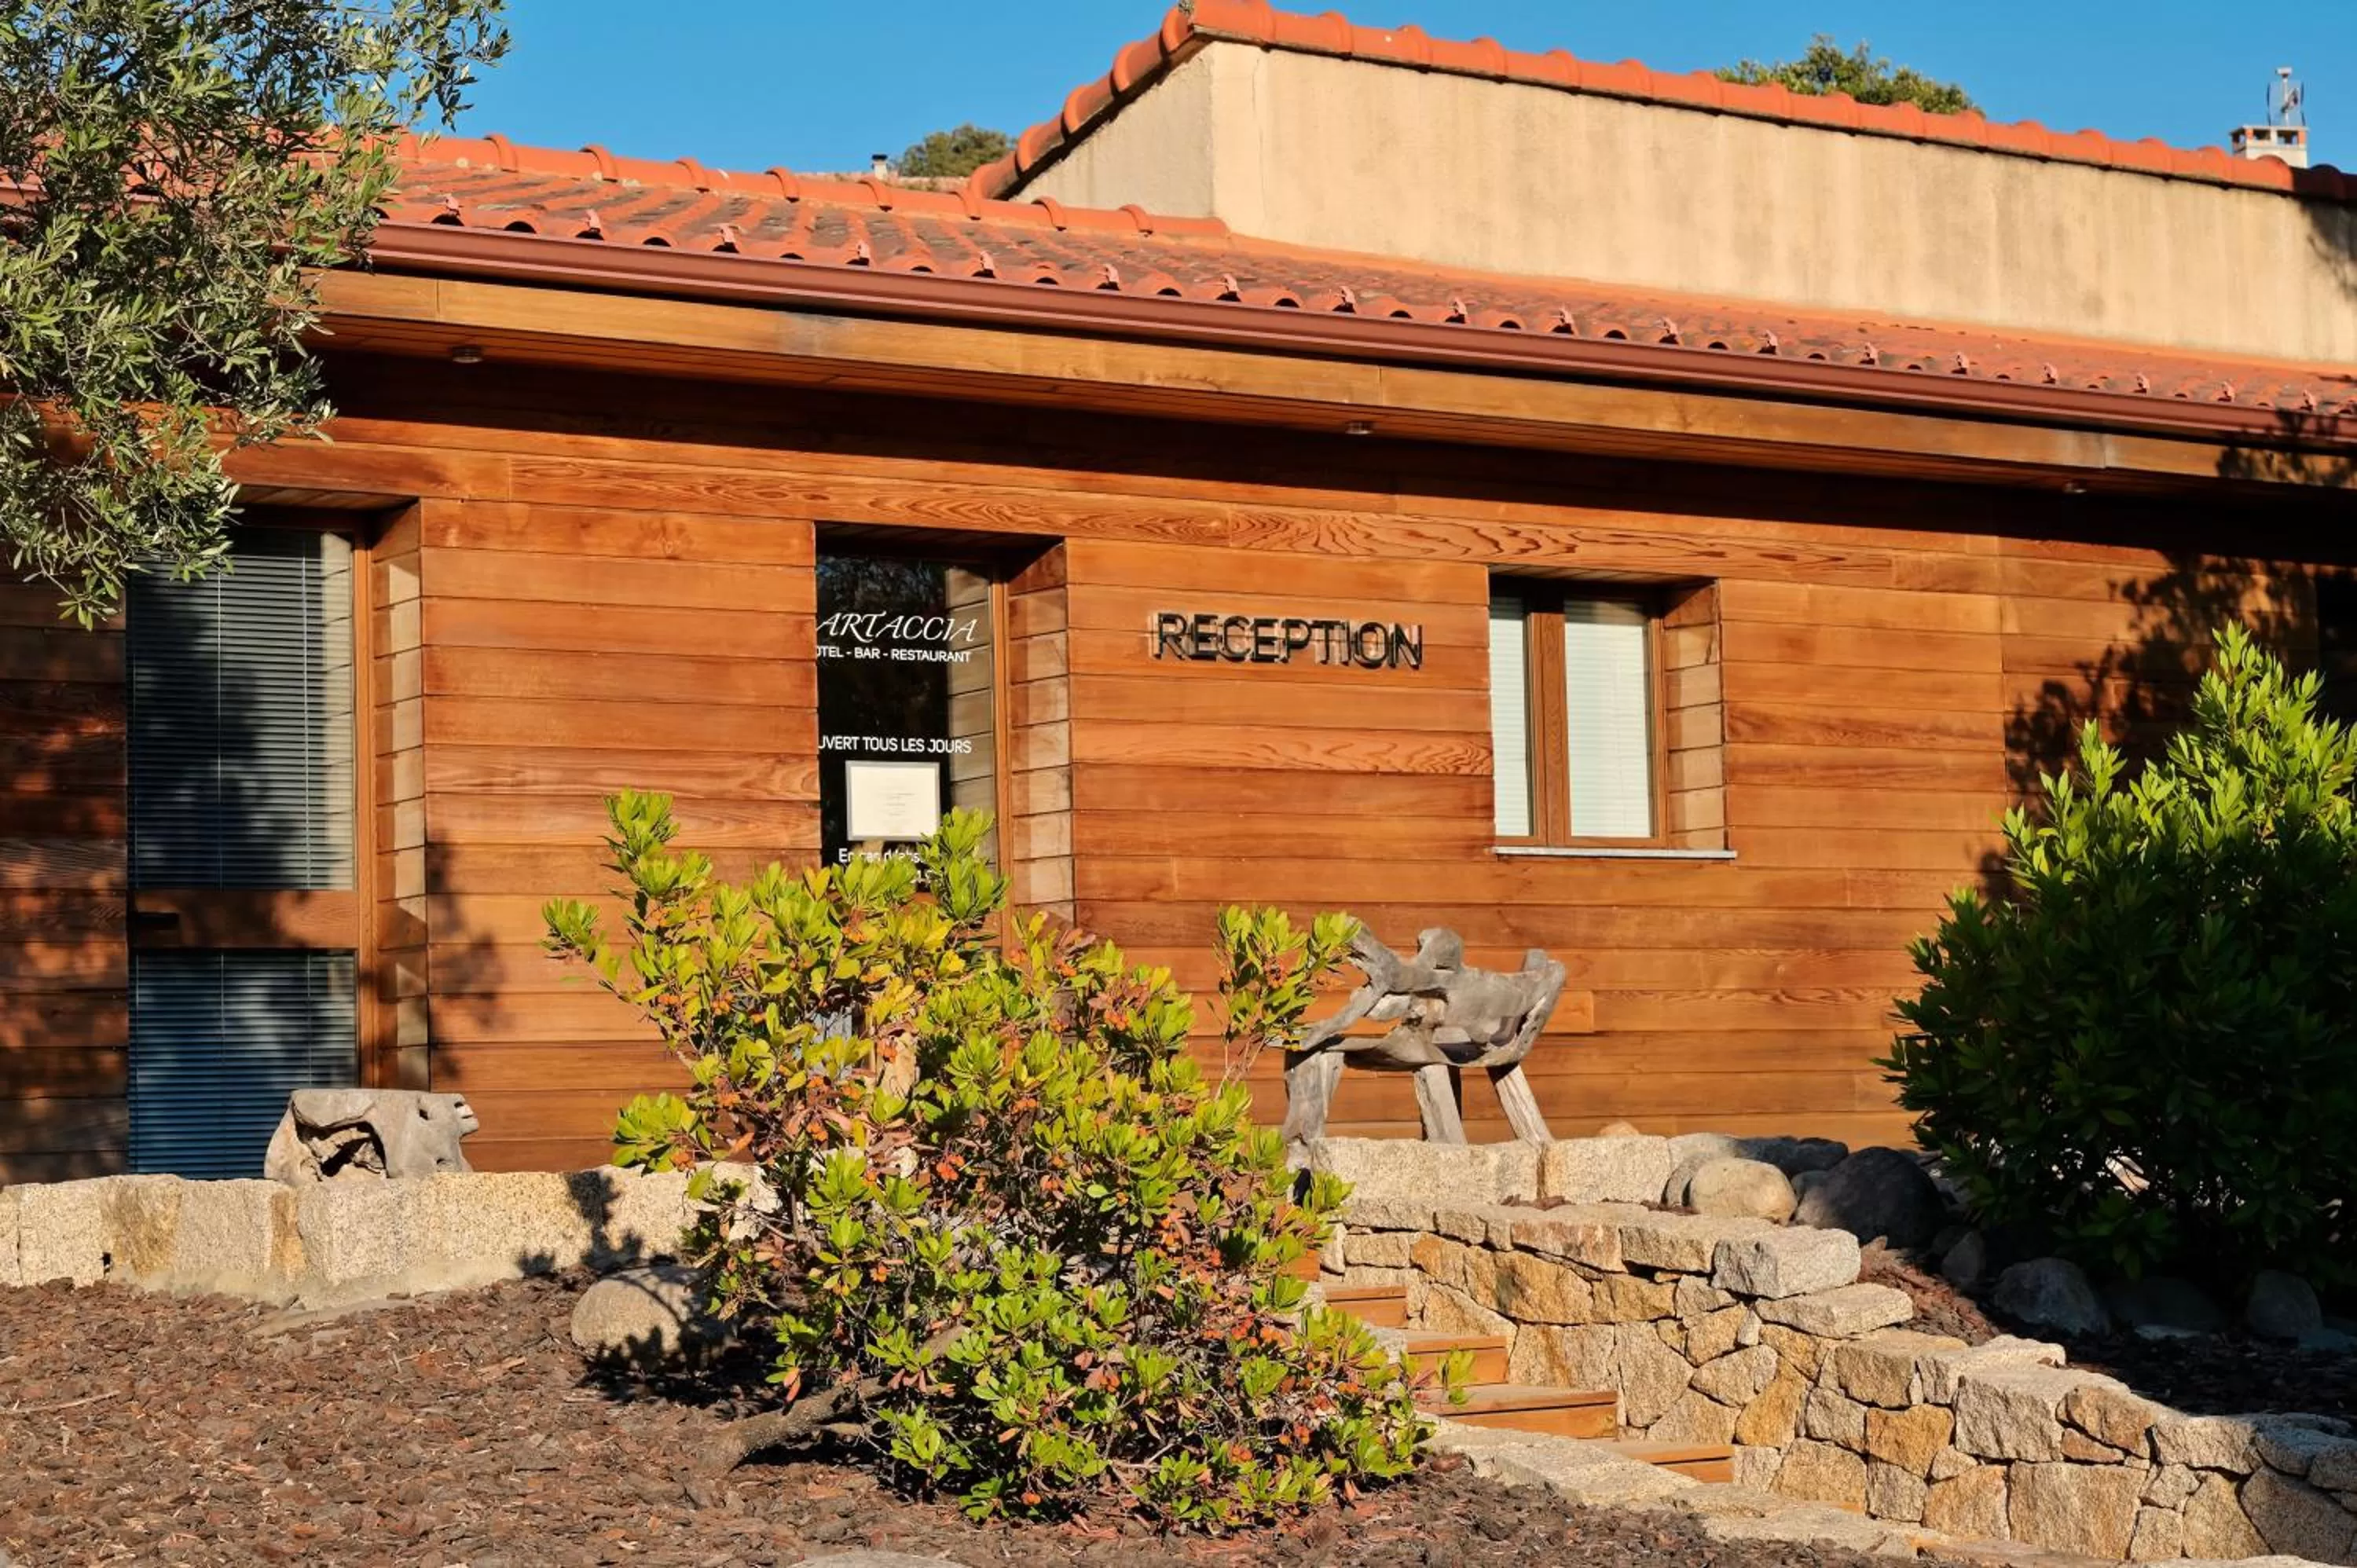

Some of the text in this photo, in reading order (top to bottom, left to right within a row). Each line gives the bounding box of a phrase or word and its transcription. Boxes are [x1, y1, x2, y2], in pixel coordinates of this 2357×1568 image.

[816, 610, 978, 643] ARTACCIA
[1149, 611, 1423, 670] RECEPTION
[854, 647, 881, 660] BAR
[891, 649, 972, 663] RESTAURANT
[862, 736, 898, 752] TOUS
[901, 738, 926, 753] LES
[927, 738, 973, 754] JOURS
